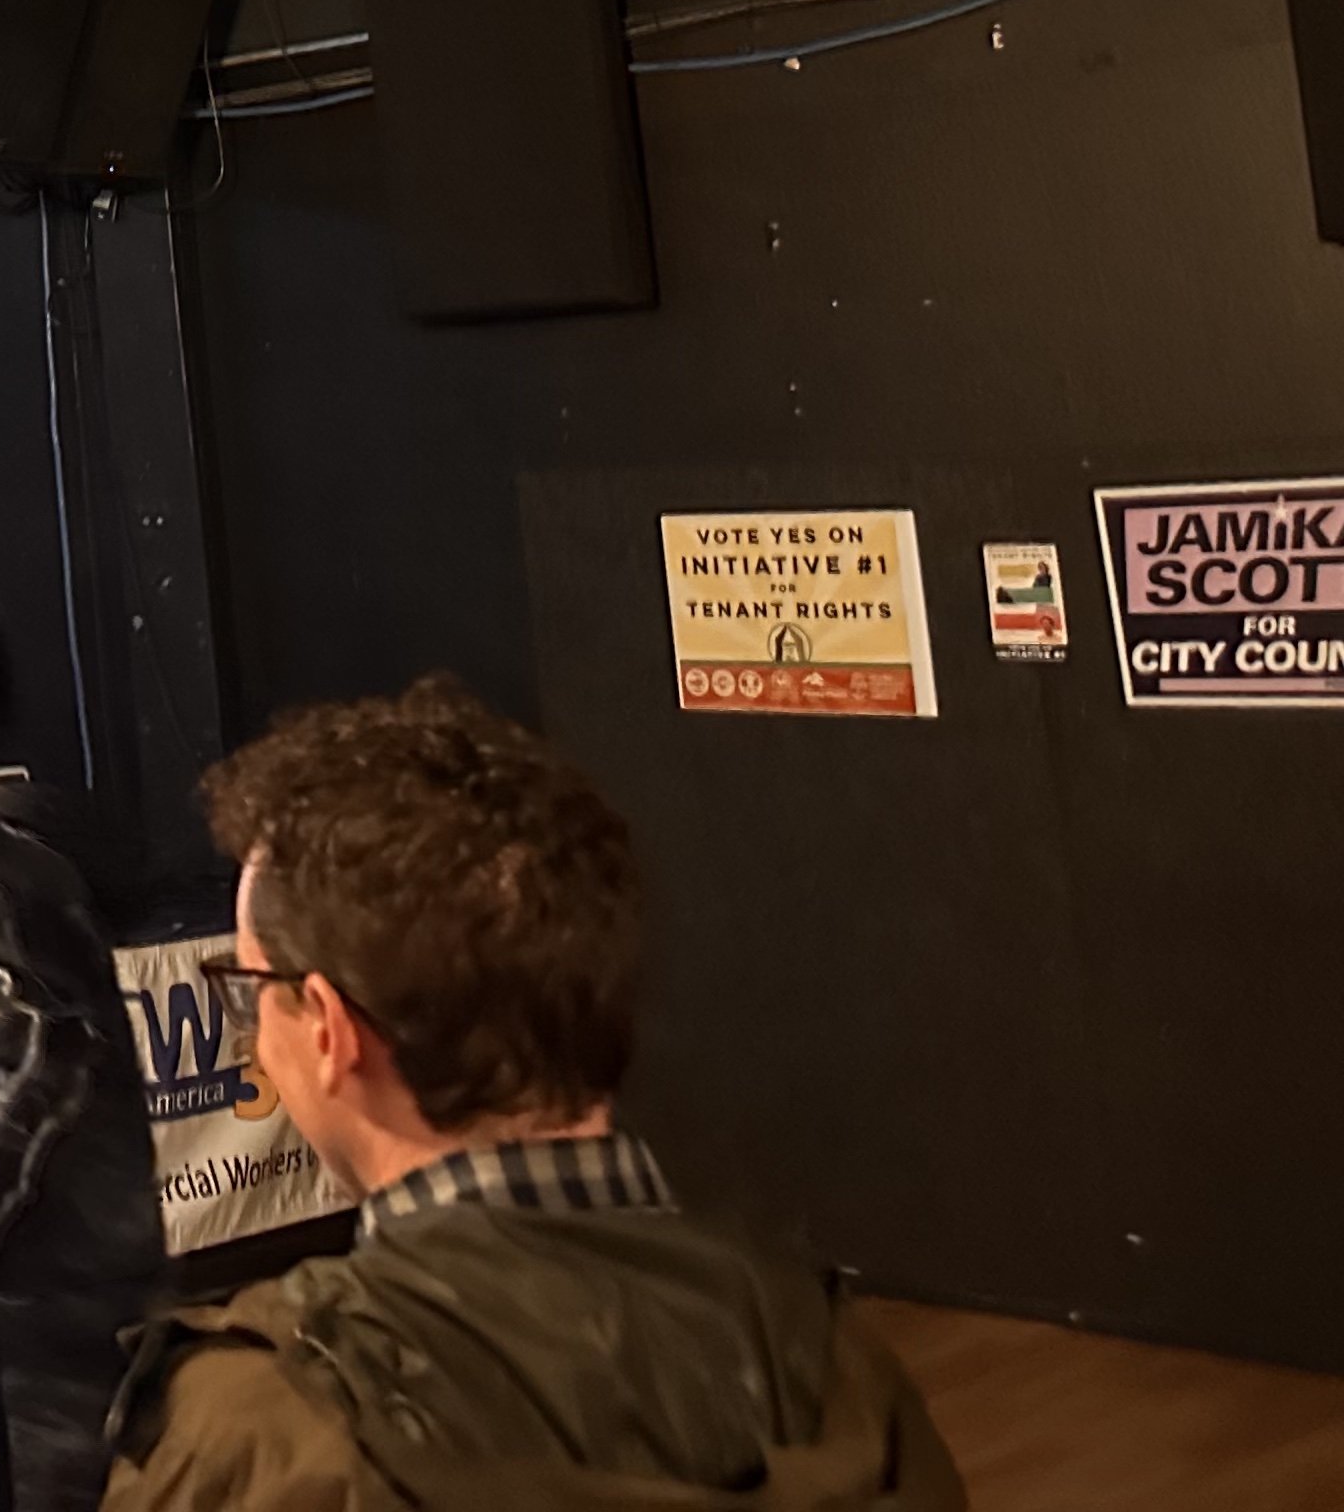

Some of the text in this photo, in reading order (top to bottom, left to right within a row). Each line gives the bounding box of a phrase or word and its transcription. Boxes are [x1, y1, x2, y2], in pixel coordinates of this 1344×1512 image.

[697, 526, 863, 545] VOTE YES ON
[681, 555, 888, 576] INITIATIVE #1
[770, 583, 797, 593] FOR
[1145, 555, 1344, 607] SCOT
[686, 601, 892, 619] TENANT RIGHTS
[1243, 615, 1297, 636] FOR
[1130, 641, 1344, 674] CITY COUN
[223, 1147, 302, 1192] Workers
